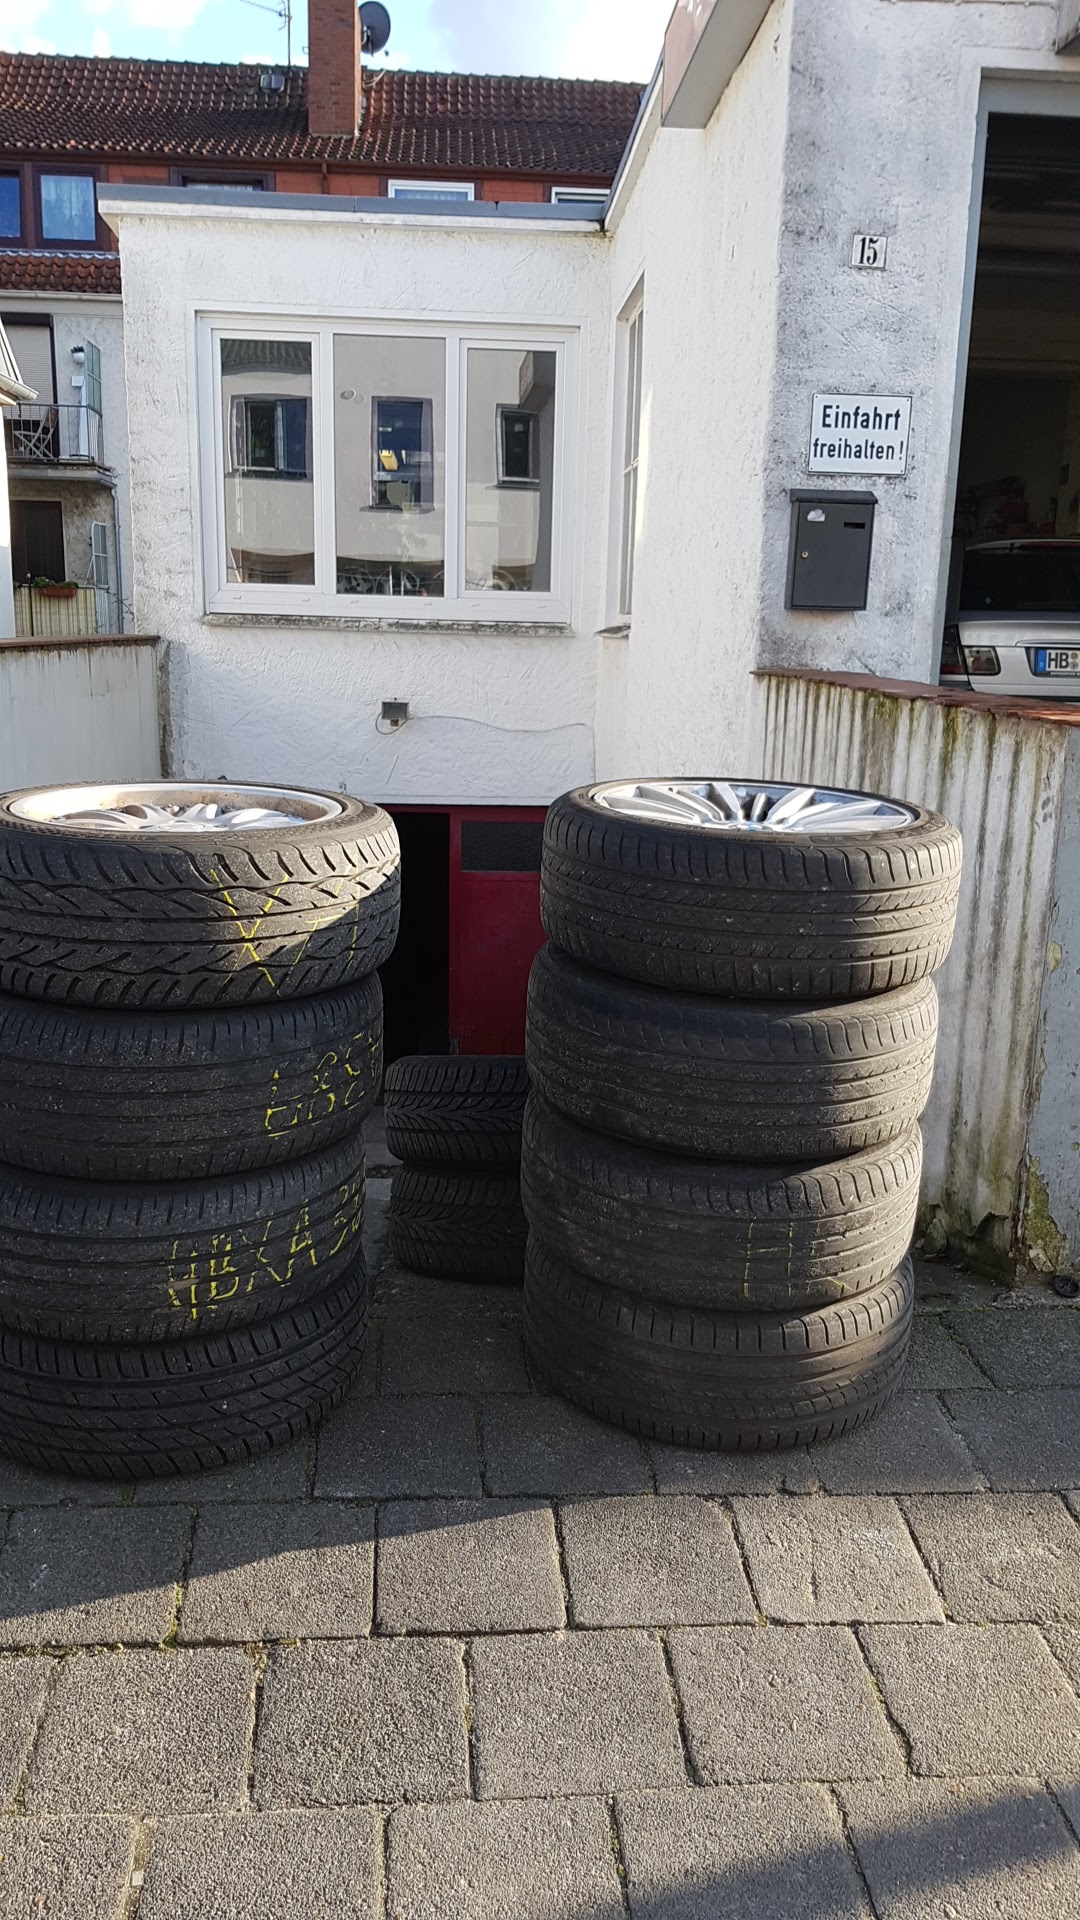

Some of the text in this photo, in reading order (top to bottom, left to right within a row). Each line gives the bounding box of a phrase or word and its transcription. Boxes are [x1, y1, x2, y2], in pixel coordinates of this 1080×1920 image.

[858, 236, 879, 265] 15
[821, 404, 901, 430] Einfahrt
[1047, 651, 1069, 669] HB
